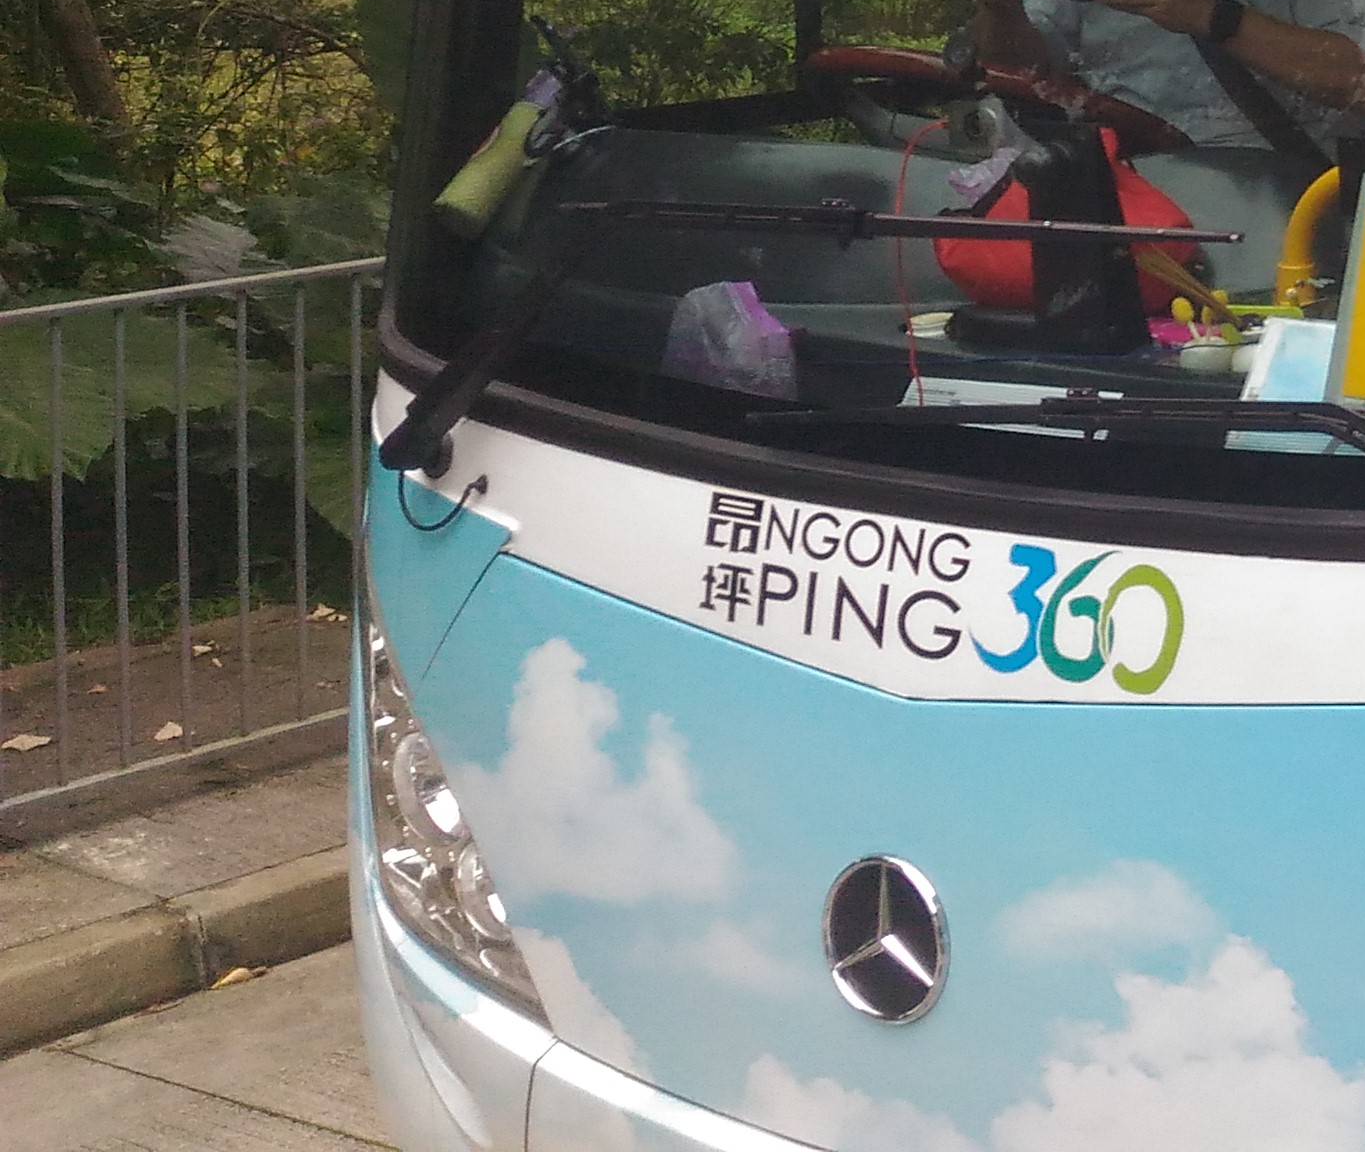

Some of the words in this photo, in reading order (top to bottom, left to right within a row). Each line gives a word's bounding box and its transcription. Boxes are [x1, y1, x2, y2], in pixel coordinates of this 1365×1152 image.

[764, 503, 972, 583] NGONG
[756, 564, 963, 660] PING
[968, 542, 1185, 695] 360
